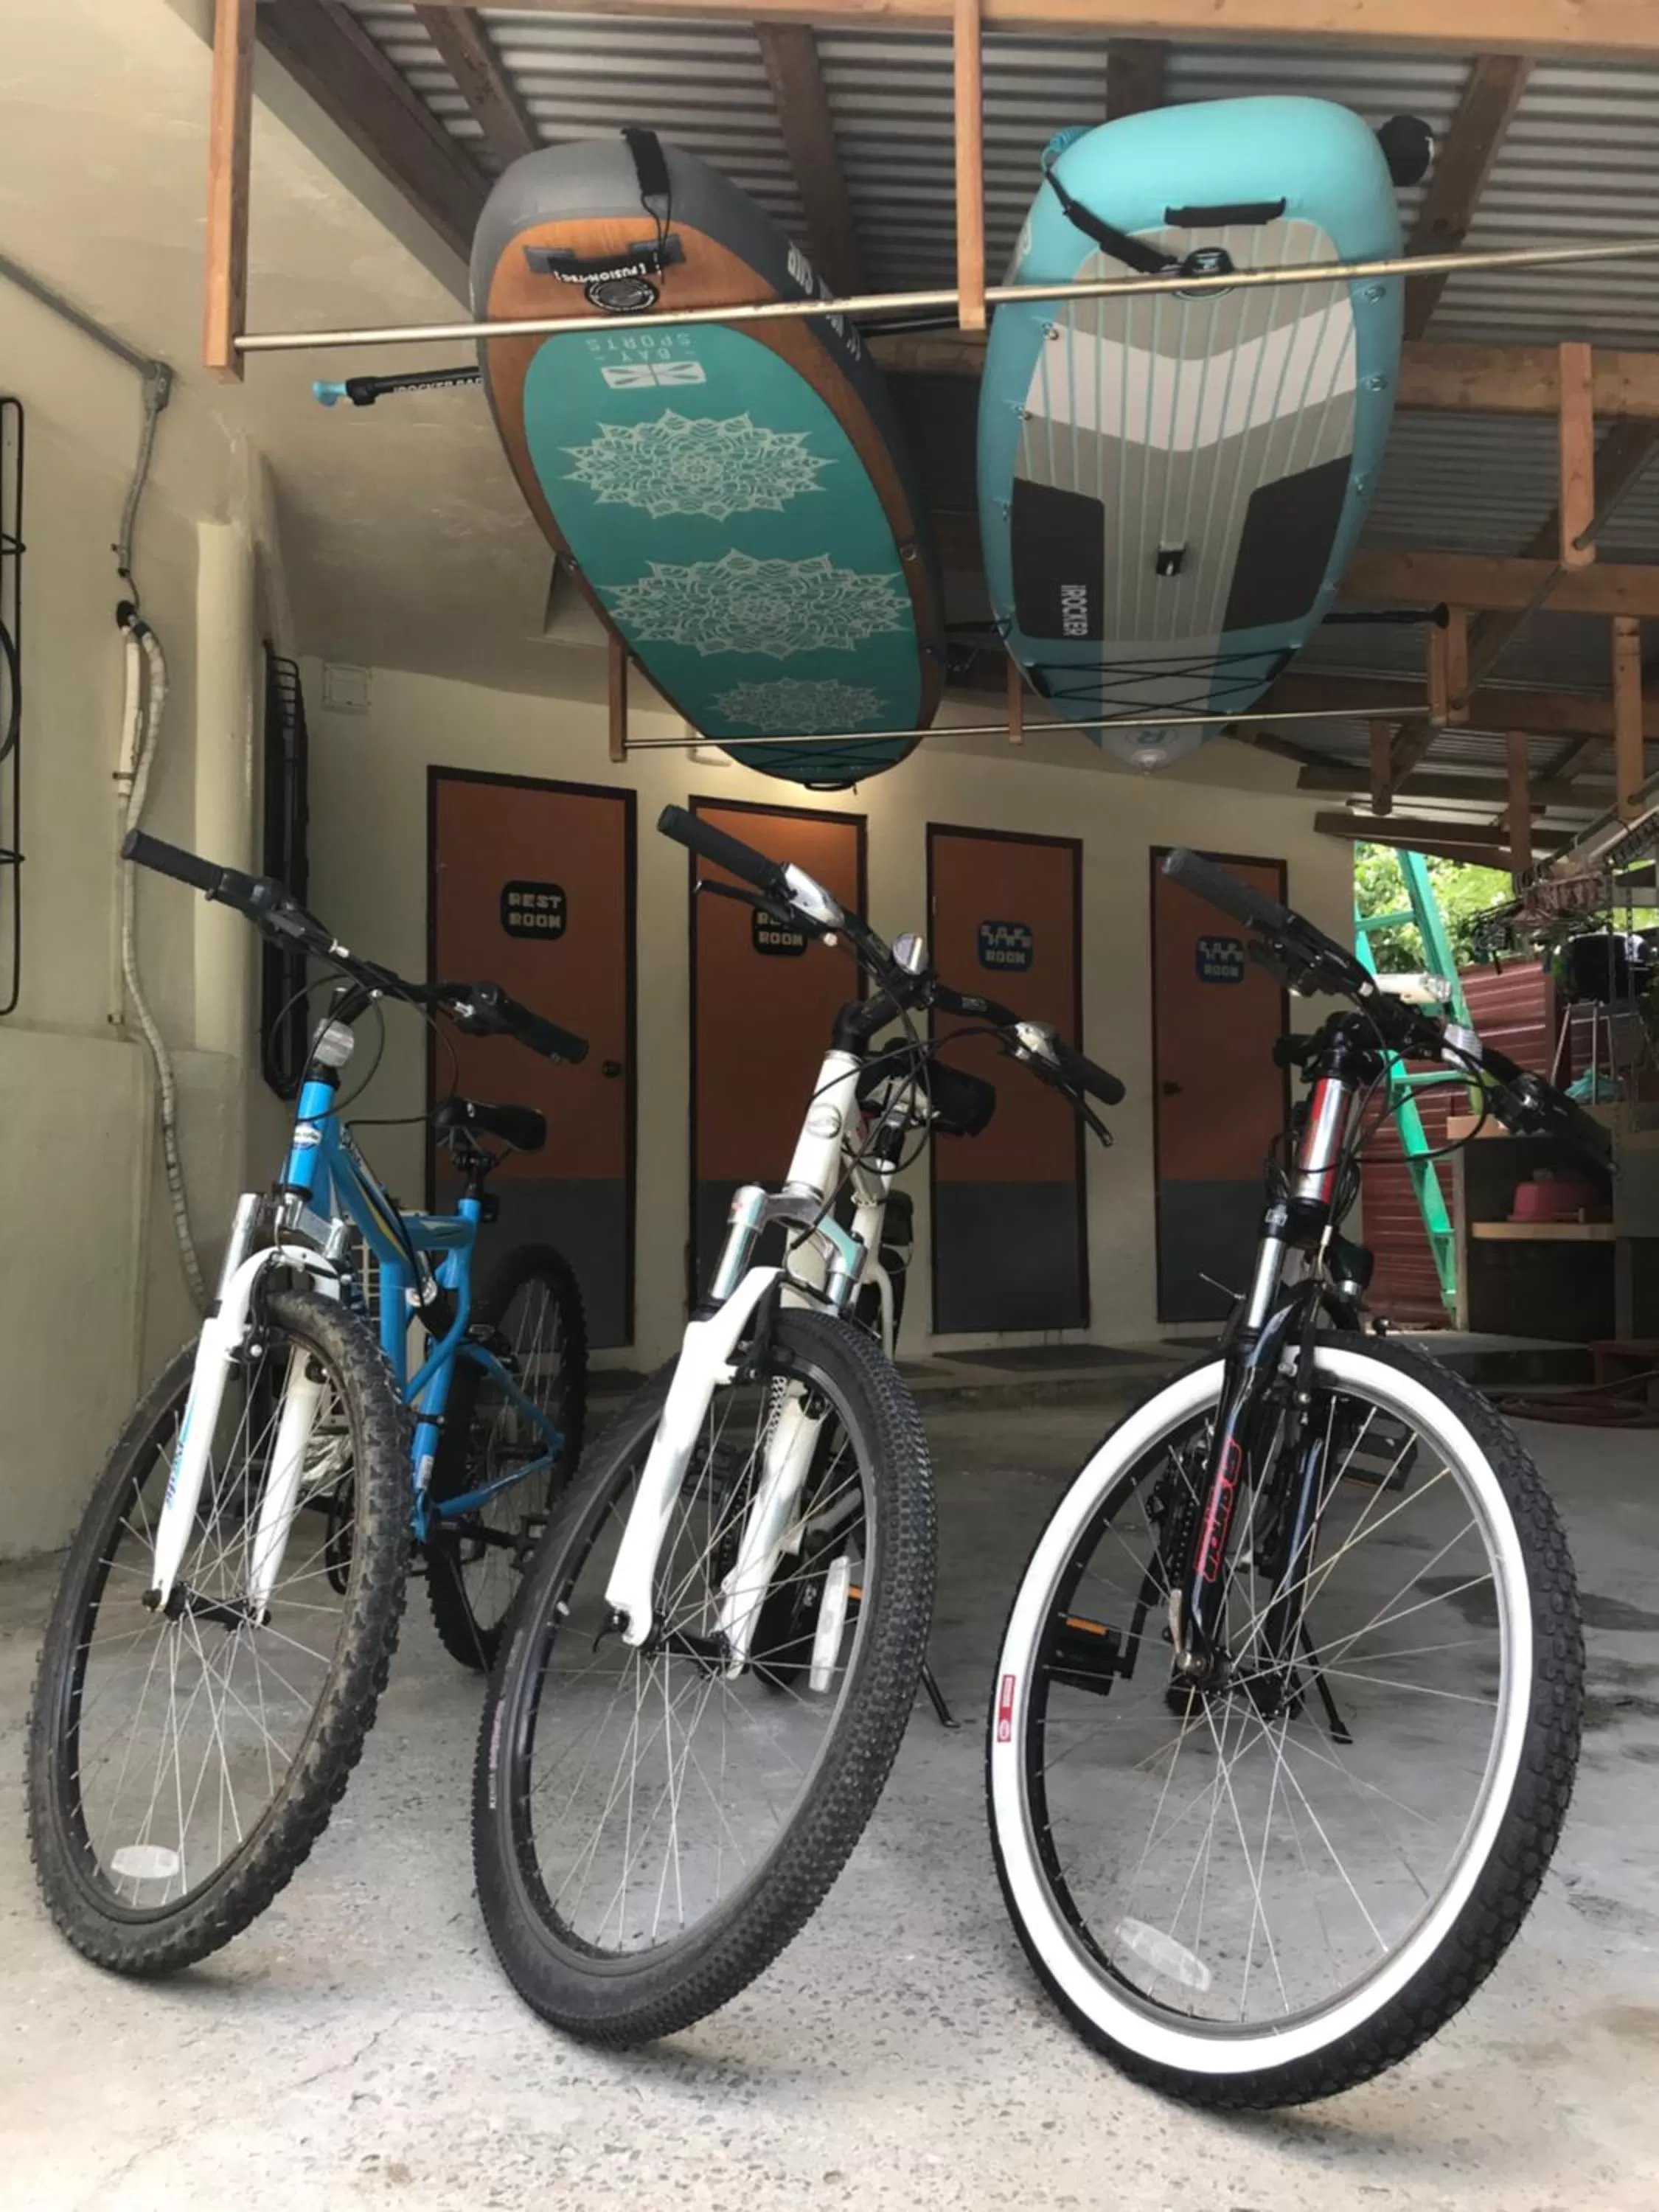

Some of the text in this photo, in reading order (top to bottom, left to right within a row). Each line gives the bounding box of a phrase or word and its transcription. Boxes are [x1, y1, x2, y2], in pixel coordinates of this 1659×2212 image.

[585, 333, 692, 352] SPORTS
[509, 891, 563, 909] REST
[509, 912, 561, 929] ROOM
[758, 931, 803, 947] ROOM
[986, 950, 1026, 964] ROOM
